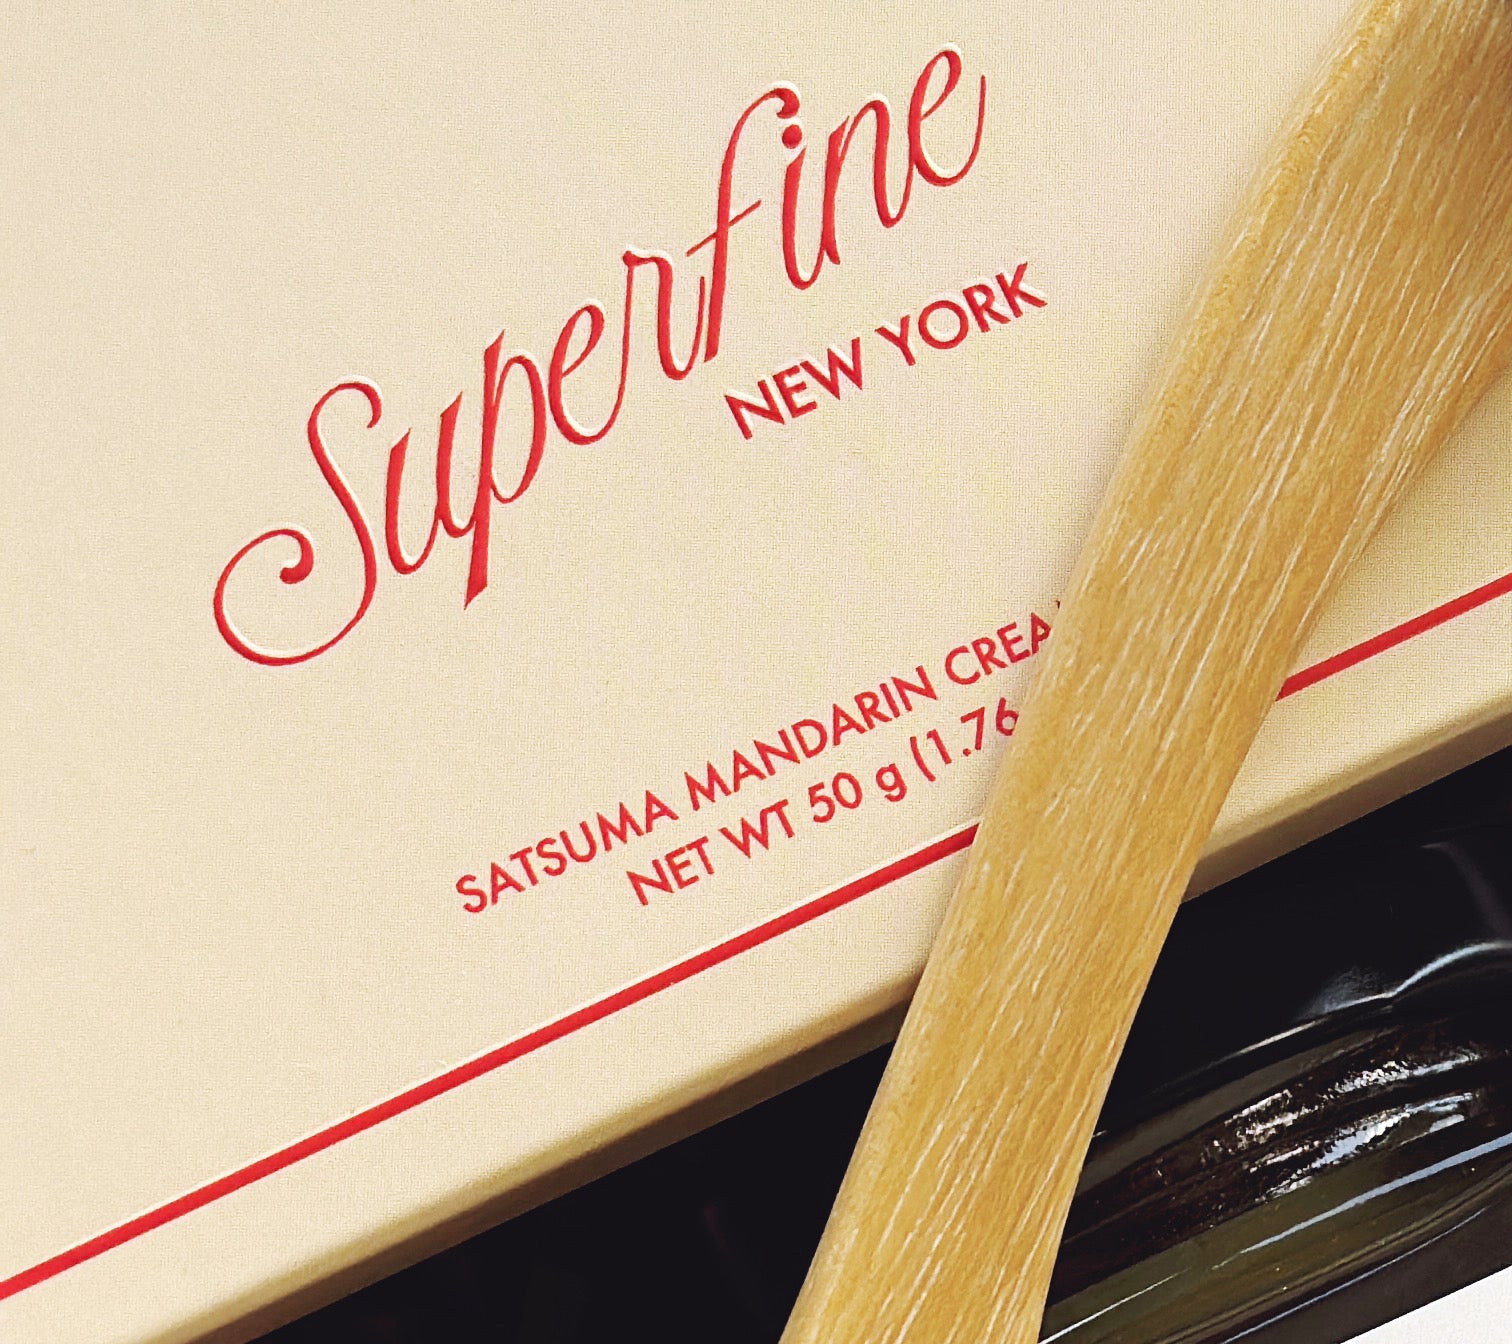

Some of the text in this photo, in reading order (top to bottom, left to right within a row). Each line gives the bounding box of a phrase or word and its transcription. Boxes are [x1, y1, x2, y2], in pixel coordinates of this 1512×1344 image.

[213, 47, 987, 666] Superfine
[723, 261, 1049, 441] NEW YORK
[454, 600, 1060, 914] SATSUMA MANDARIN CREA
[625, 835, 715, 906] NET
[718, 798, 796, 859] WT
[807, 769, 865, 824] 50
[874, 760, 907, 803] g
